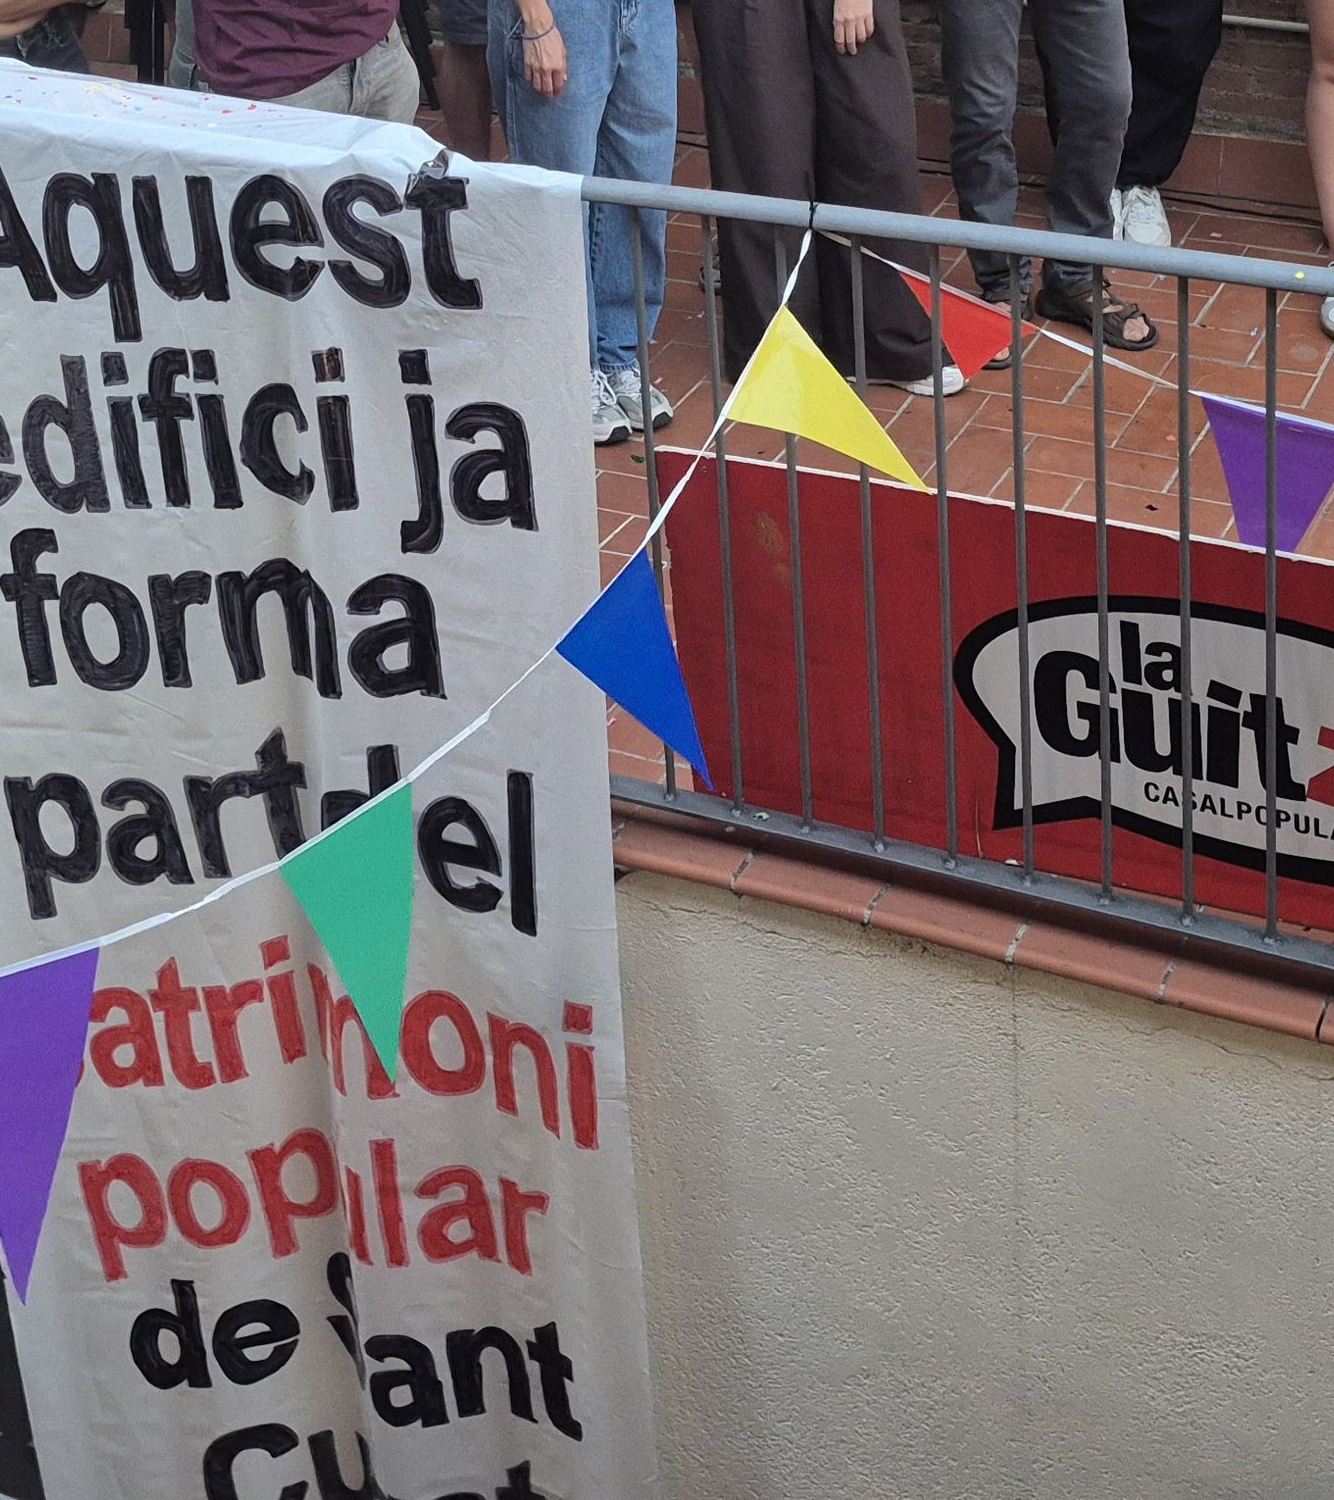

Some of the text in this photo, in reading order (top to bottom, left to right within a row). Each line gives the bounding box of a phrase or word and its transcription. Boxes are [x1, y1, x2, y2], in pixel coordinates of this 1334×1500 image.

[399, 348, 539, 554] ja
[0, 527, 448, 700] forma
[1119, 620, 1192, 696] la
[3, 726, 308, 920] part
[73, 935, 599, 1150] atrimoni
[129, 1278, 301, 1390] de
